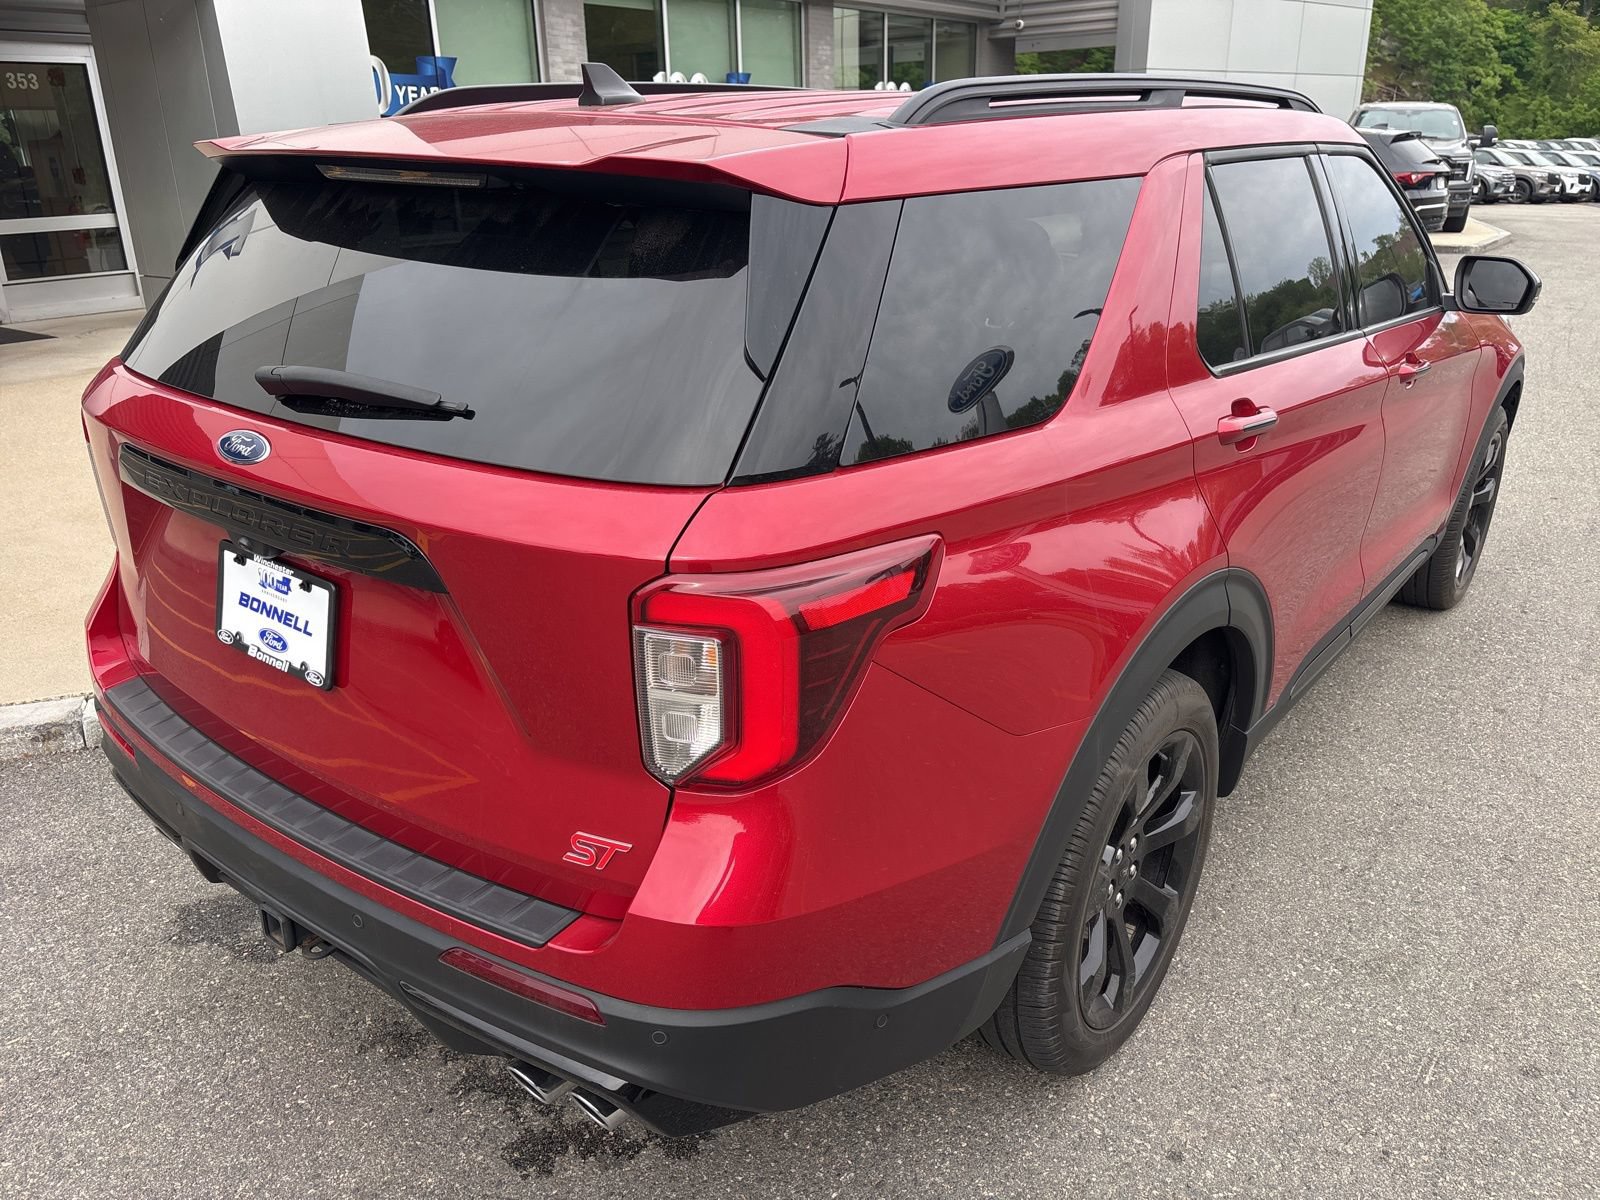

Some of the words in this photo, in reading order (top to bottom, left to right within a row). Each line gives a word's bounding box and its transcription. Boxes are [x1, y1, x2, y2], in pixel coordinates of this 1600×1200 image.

[6, 72, 39, 90] 353
[225, 434, 257, 457] Ford
[143, 469, 350, 556] EXPLORER
[253, 554, 294, 576] Winchester
[238, 591, 313, 637] BONNELL
[263, 630, 284, 651] Ford
[247, 645, 291, 673] Bonnell
[562, 831, 633, 870] ST
